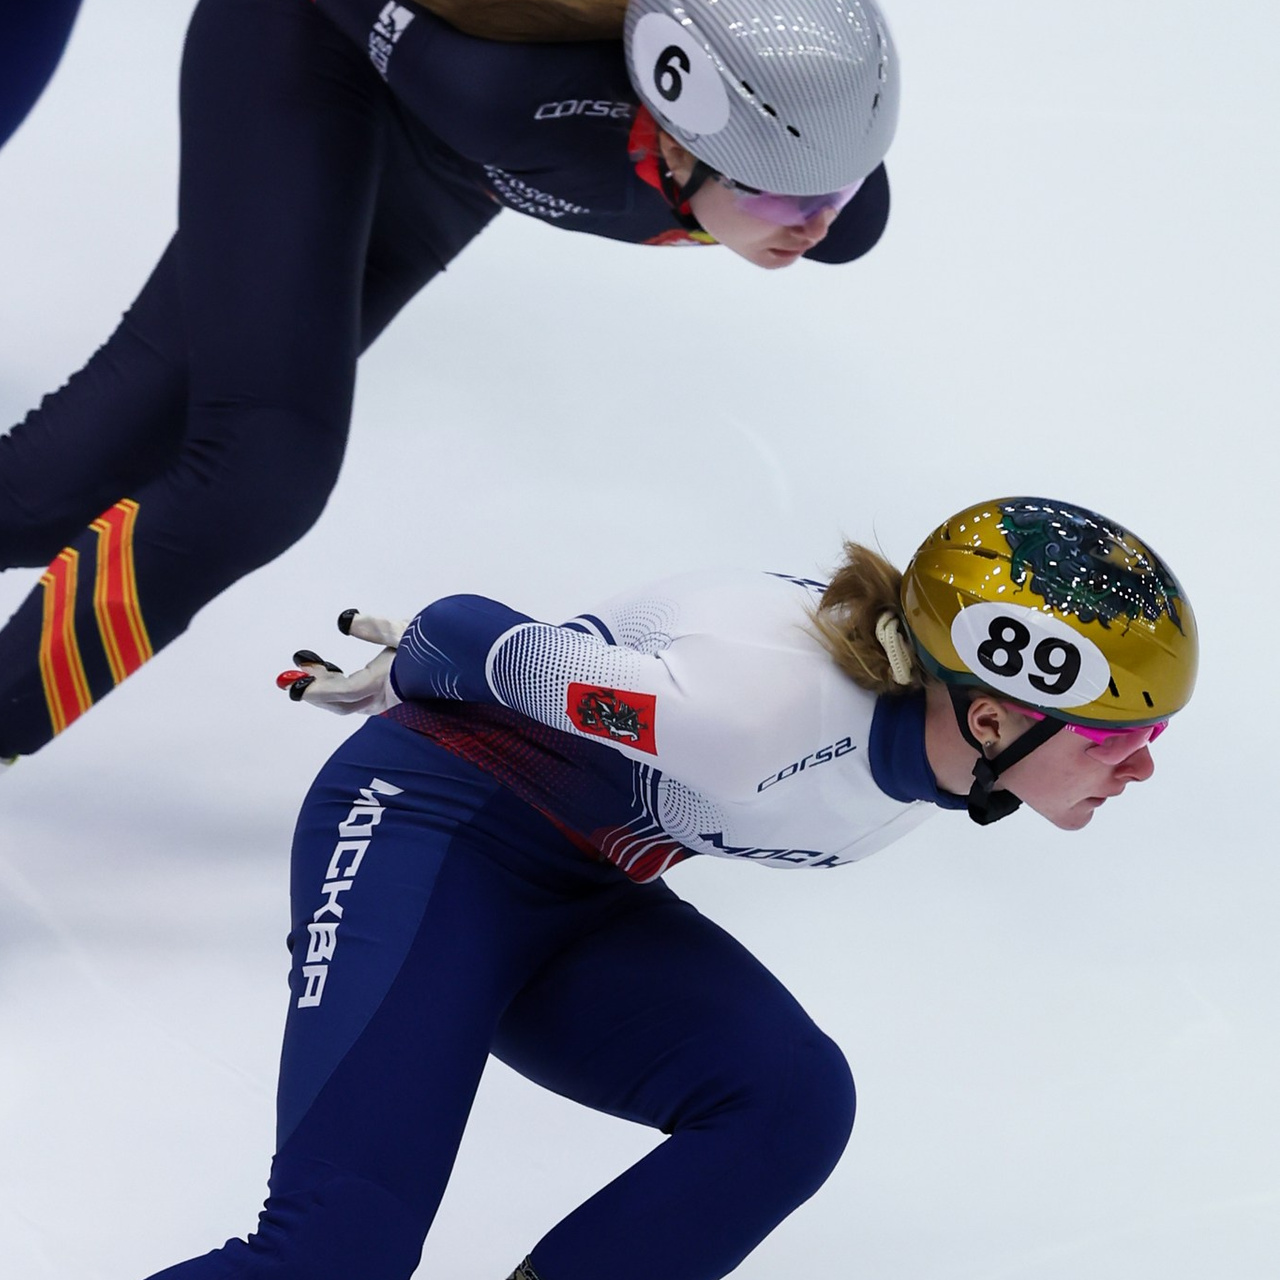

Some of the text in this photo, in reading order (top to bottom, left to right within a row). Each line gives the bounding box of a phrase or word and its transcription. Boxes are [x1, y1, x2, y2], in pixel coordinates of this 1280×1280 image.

[653, 45, 691, 102] 6
[533, 99, 632, 120] corsa
[977, 616, 1081, 695] 89
[757, 736, 857, 793] corsa
[297, 777, 405, 1009] МОСКВА
